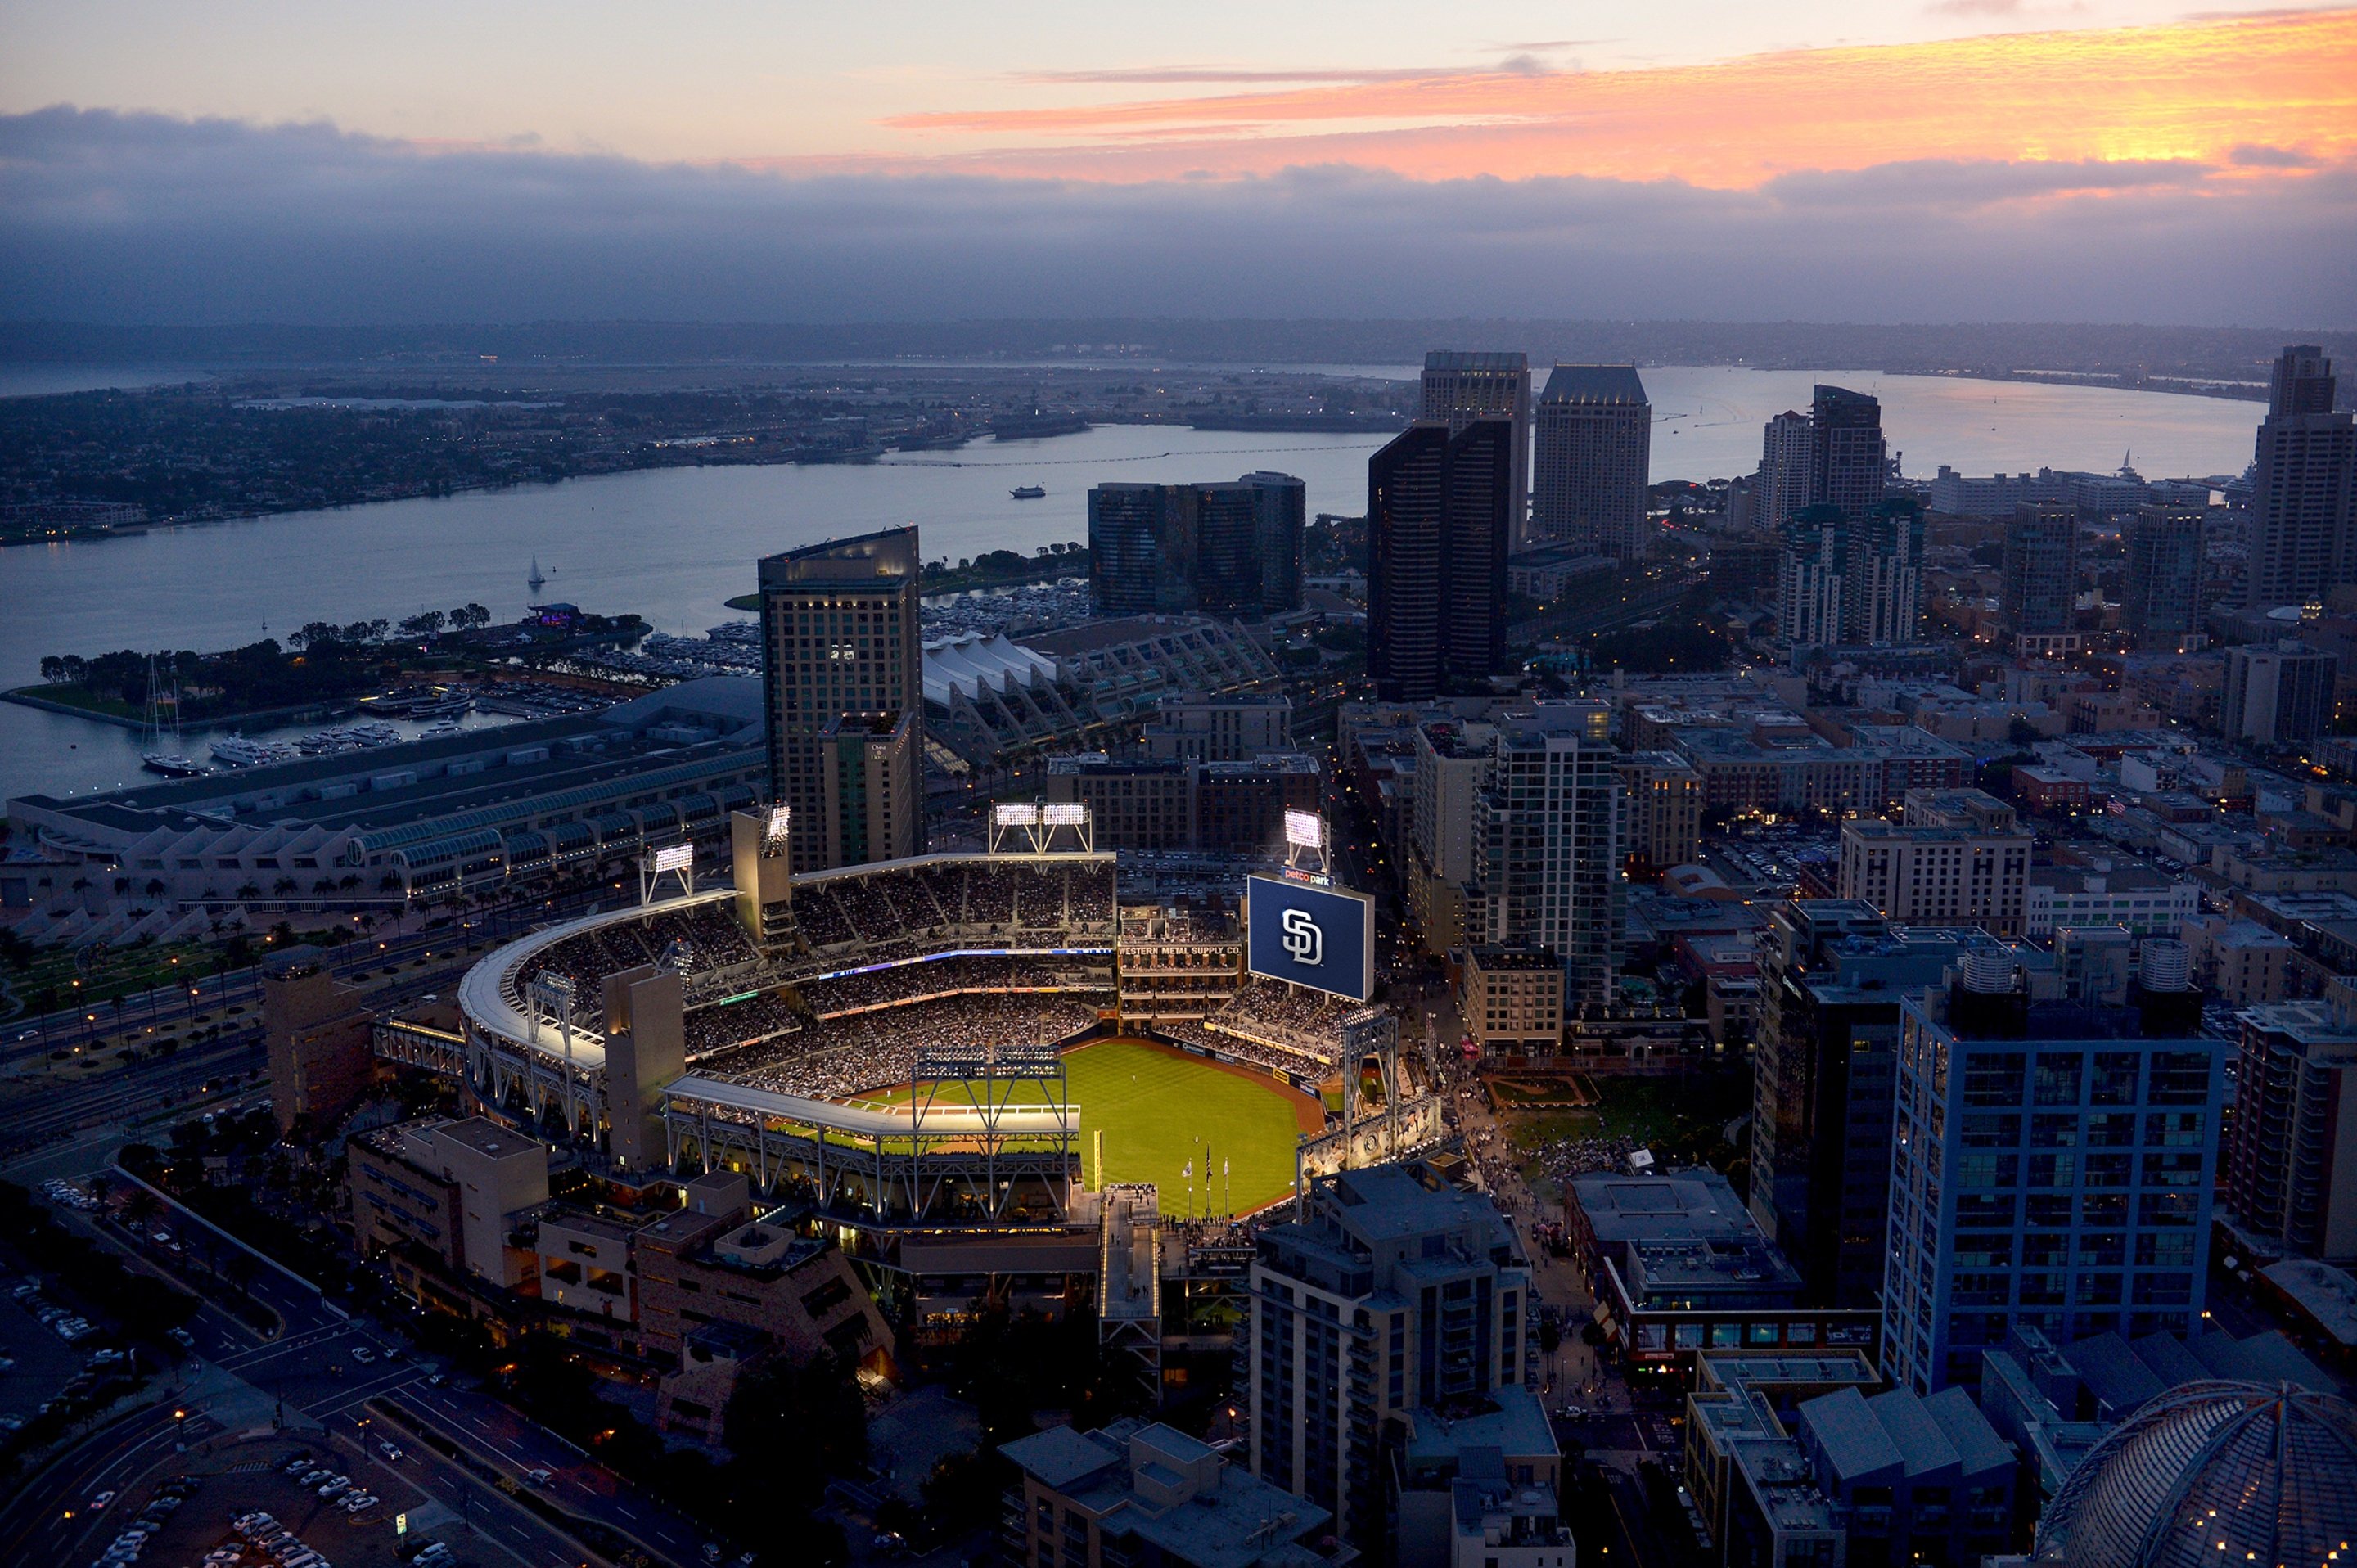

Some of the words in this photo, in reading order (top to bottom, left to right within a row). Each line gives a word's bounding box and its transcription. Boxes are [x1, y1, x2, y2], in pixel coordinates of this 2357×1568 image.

[1286, 869, 1309, 881] petco
[1310, 875, 1329, 886] park
[1282, 908, 1323, 965] SD
[1119, 947, 1158, 955] WESTERN
[1162, 947, 1191, 955] METAL
[1192, 947, 1224, 955] SUPPLY
[1226, 947, 1242, 955] CO.
